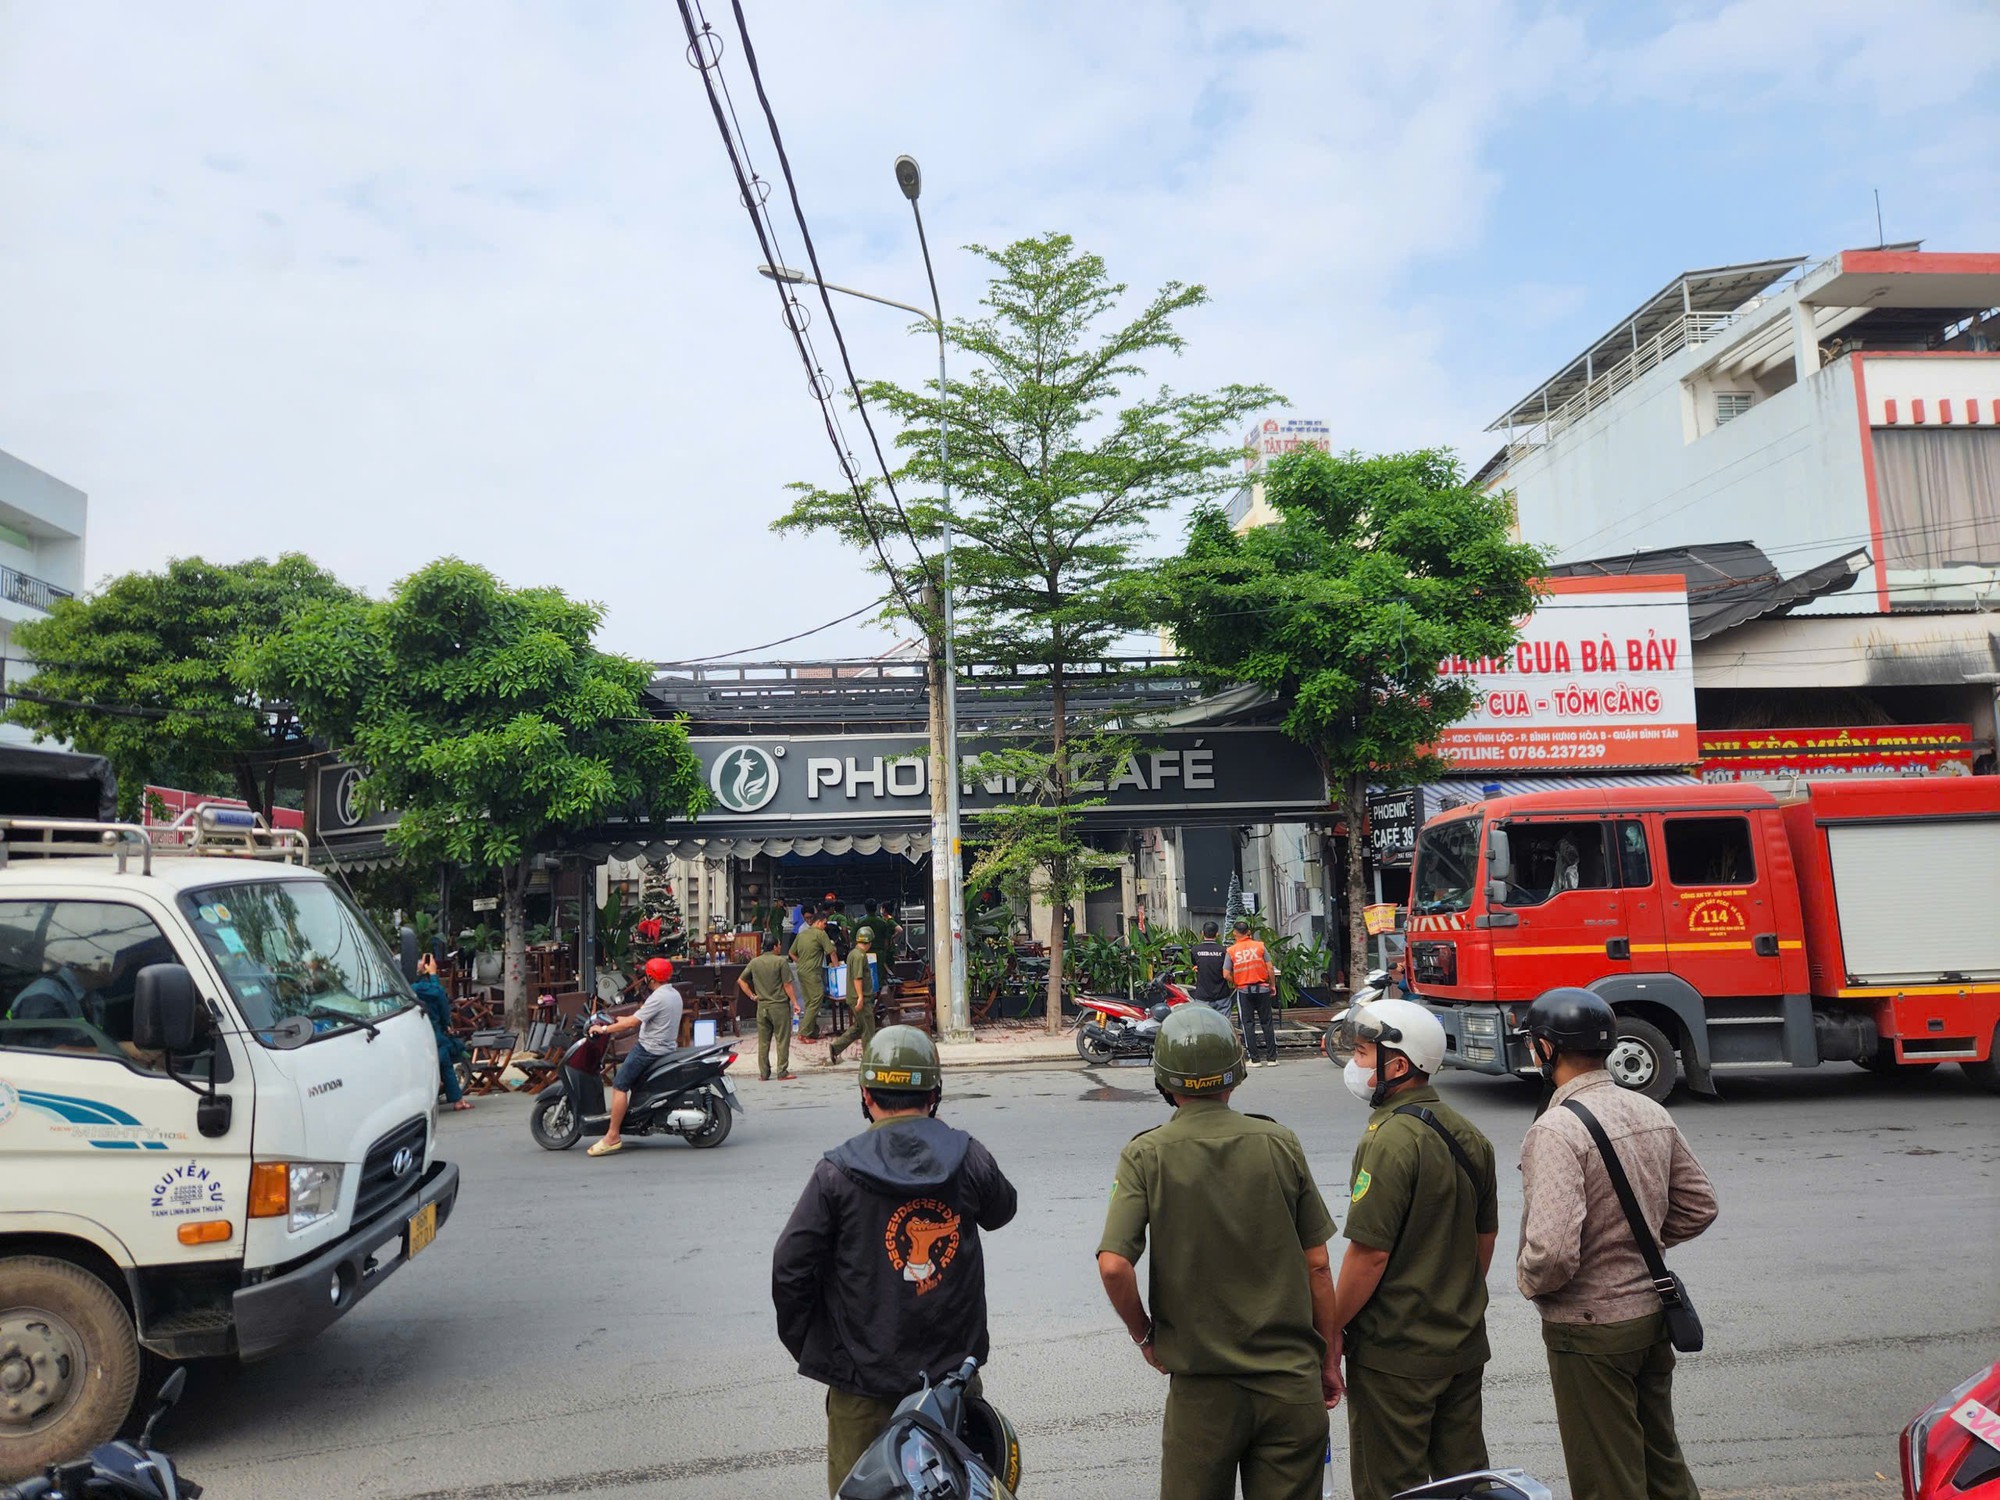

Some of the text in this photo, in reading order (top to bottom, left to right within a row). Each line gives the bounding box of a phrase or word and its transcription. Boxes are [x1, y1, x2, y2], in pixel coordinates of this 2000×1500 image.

[1517, 640, 1571, 675] CUA
[1580, 633, 1617, 673] BÀ
[1626, 628, 1678, 672] BẢY
[1488, 682, 1662, 717] CUA TÔM CÀNG
[1452, 734, 1471, 743] KDC
[1496, 731, 1514, 744] LỘC
[1600, 731, 1606, 740] B
[1437, 743, 1606, 760] HOTLINE: 0786.237239
[1373, 801, 1408, 820] PHOENIX
[1373, 822, 1414, 848] CAFÉ 39
[1701, 910, 1728, 923] 114
[1235, 947, 1258, 962] SPX
[308, 1078, 343, 1098] HYUNDAI
